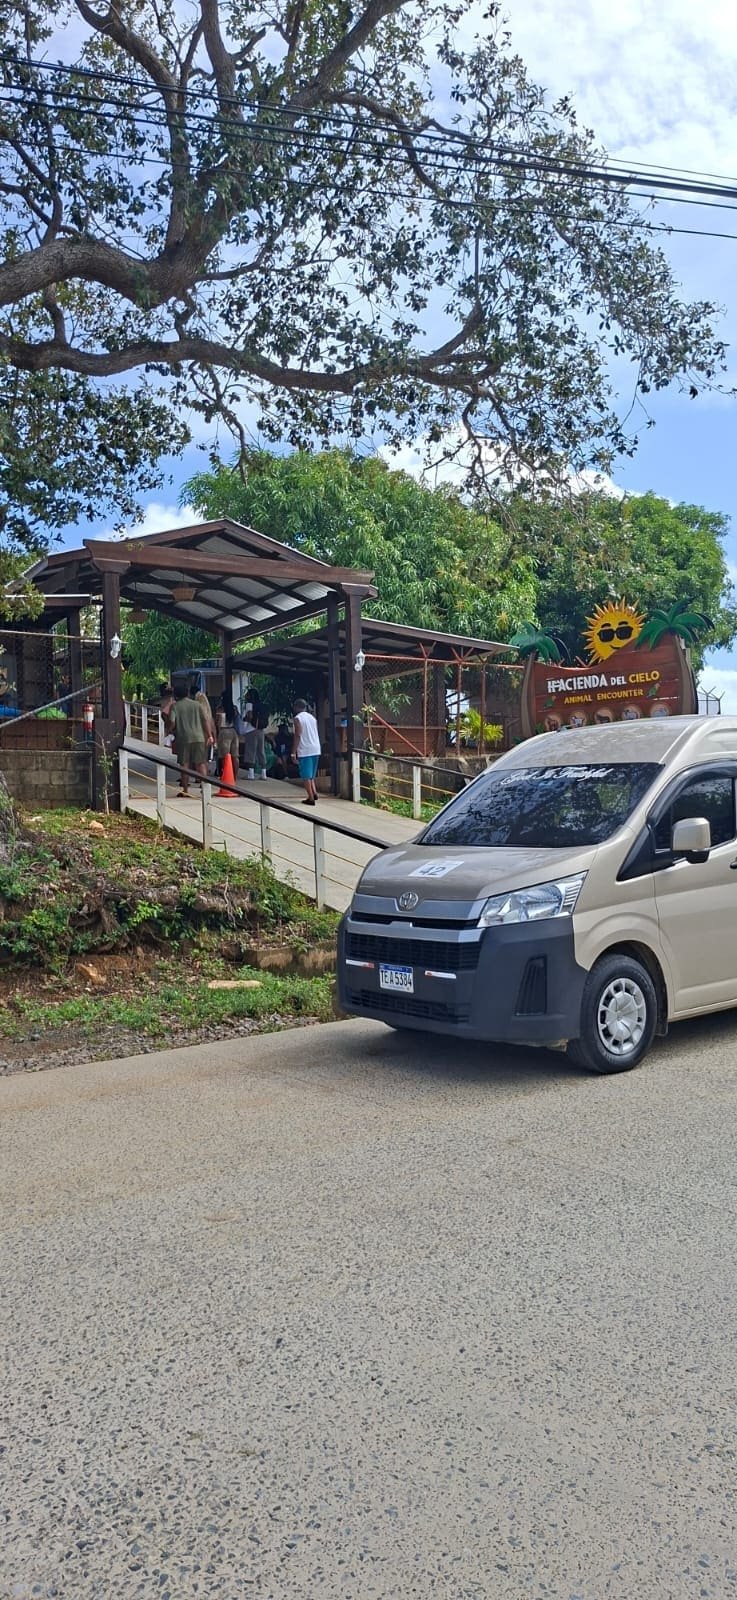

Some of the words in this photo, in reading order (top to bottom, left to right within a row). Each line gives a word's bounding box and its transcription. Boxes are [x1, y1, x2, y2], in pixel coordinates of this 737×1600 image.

[547, 673, 608, 693] HACIENDA
[610, 675, 627, 685] DEL
[628, 670, 660, 684] CIELO
[564, 694, 592, 704] ANIMAL
[596, 688, 644, 701] ENCOUNTER
[418, 866, 446, 876] 42
